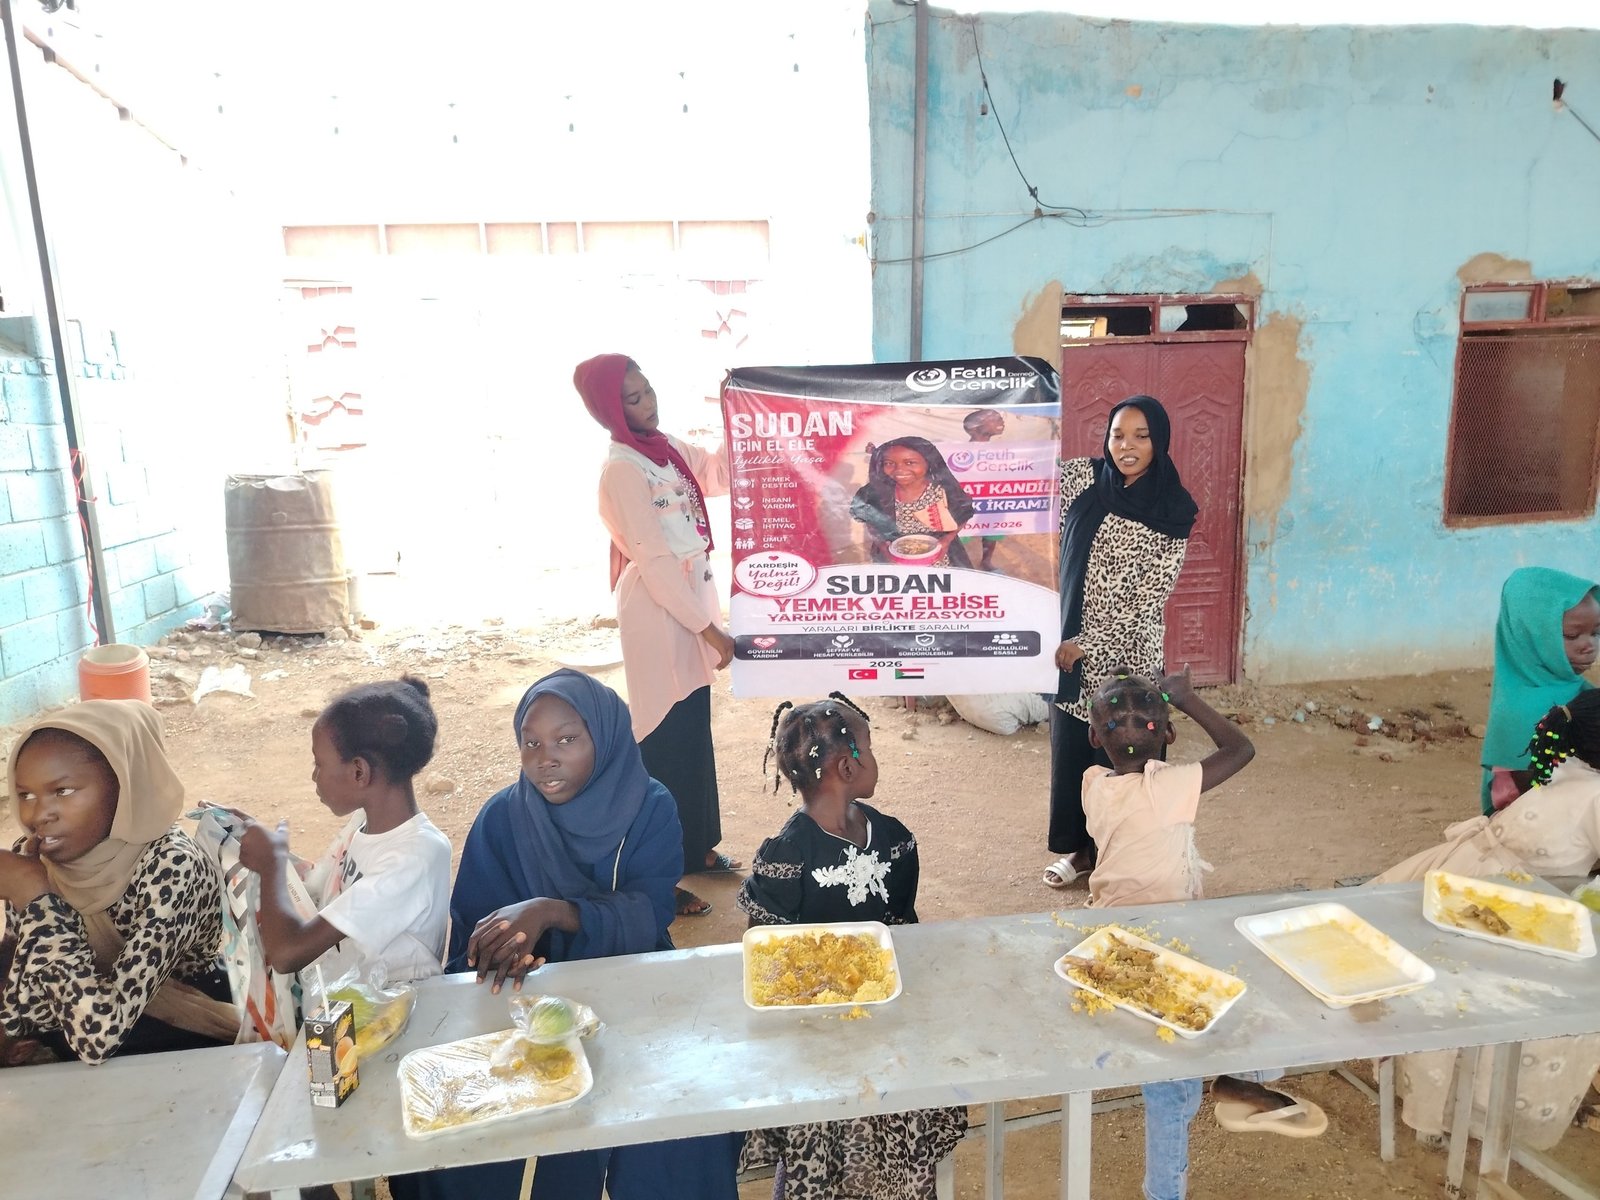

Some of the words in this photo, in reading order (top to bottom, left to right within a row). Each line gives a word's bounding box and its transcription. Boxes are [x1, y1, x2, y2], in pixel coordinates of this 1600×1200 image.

[950, 365, 1006, 379] Fetih
[950, 376, 1036, 391] Gençlik
[731, 410, 853, 439] SUDAN
[766, 439, 785, 452] EL
[789, 438, 816, 451] ELE
[963, 483, 985, 495] AT
[971, 501, 983, 511] K
[985, 499, 1049, 511] İKRAMI
[963, 522, 990, 530] DAN
[992, 520, 1023, 529] 2026
[748, 562, 799, 570] KARDEŞİN
[748, 569, 799, 580] Yalnız
[753, 576, 800, 591] Değil!
[826, 573, 951, 596] SUDAN
[773, 597, 868, 613] YEMEK
[870, 596, 904, 611] VE
[911, 592, 999, 611] ELBİSE
[841, 610, 1006, 622] ORGANİZASYONU
[802, 625, 858, 633] YARALARI
[862, 623, 916, 632] BİRLİKTE
[918, 623, 970, 631] SARALIM
[869, 660, 903, 668] 2026
